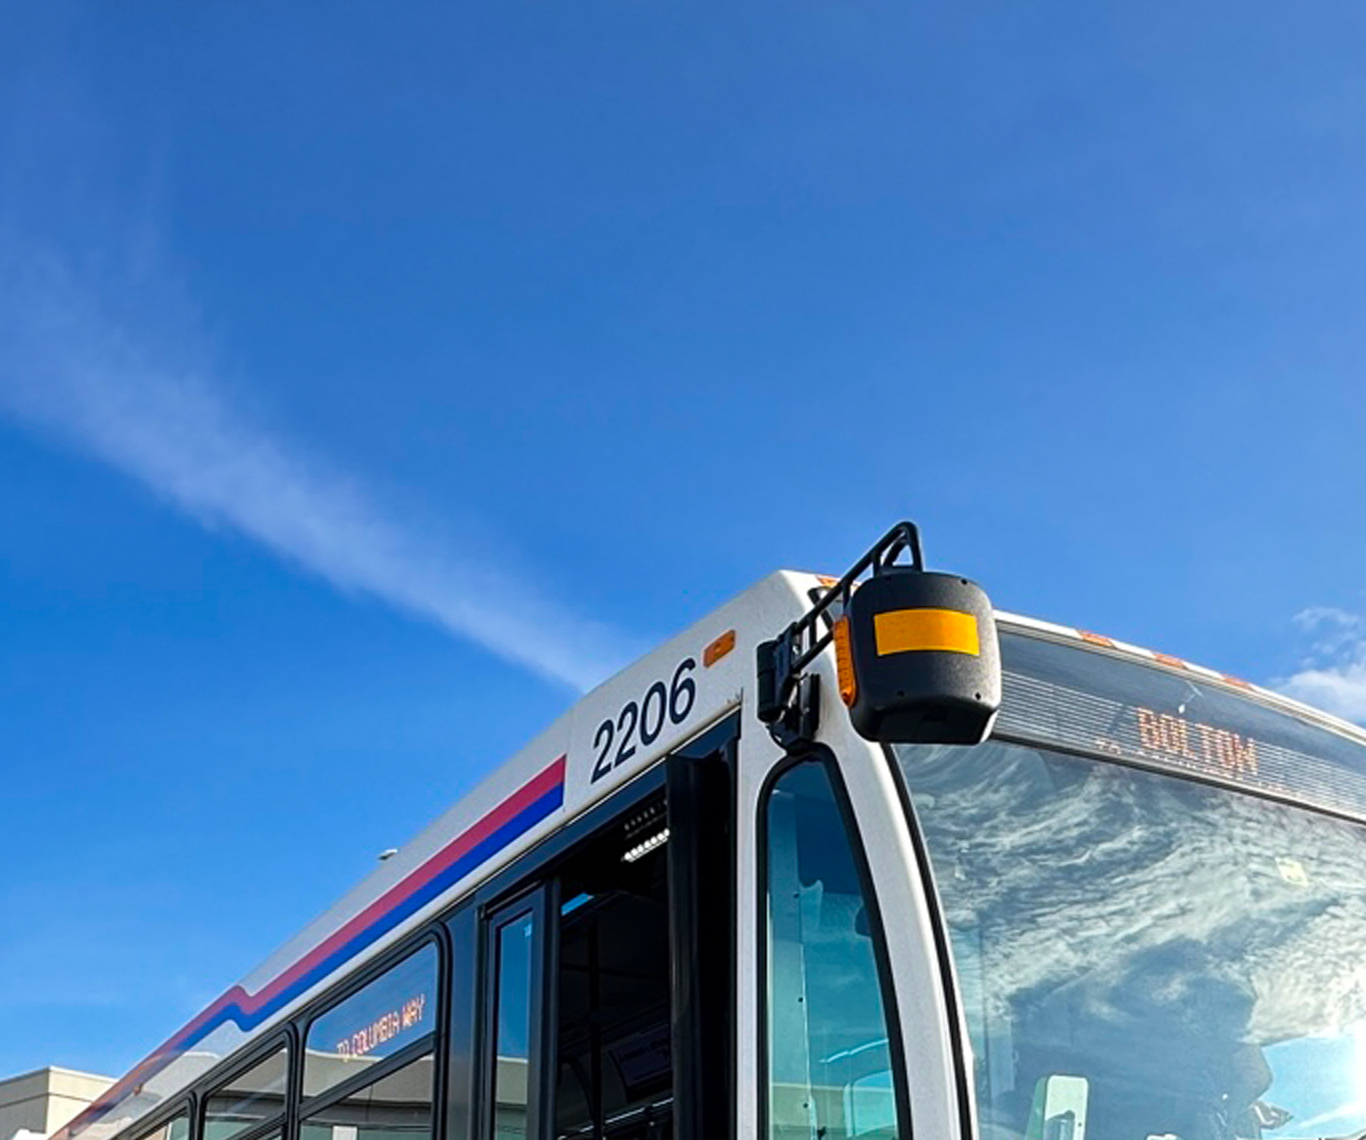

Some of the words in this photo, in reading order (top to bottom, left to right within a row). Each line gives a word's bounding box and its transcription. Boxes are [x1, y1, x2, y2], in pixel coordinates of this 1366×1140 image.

[590, 657, 697, 785] 2206
[1136, 706, 1259, 775] BOLTON
[351, 1010, 400, 1059] COLUMBIA
[401, 992, 426, 1031] WAY
